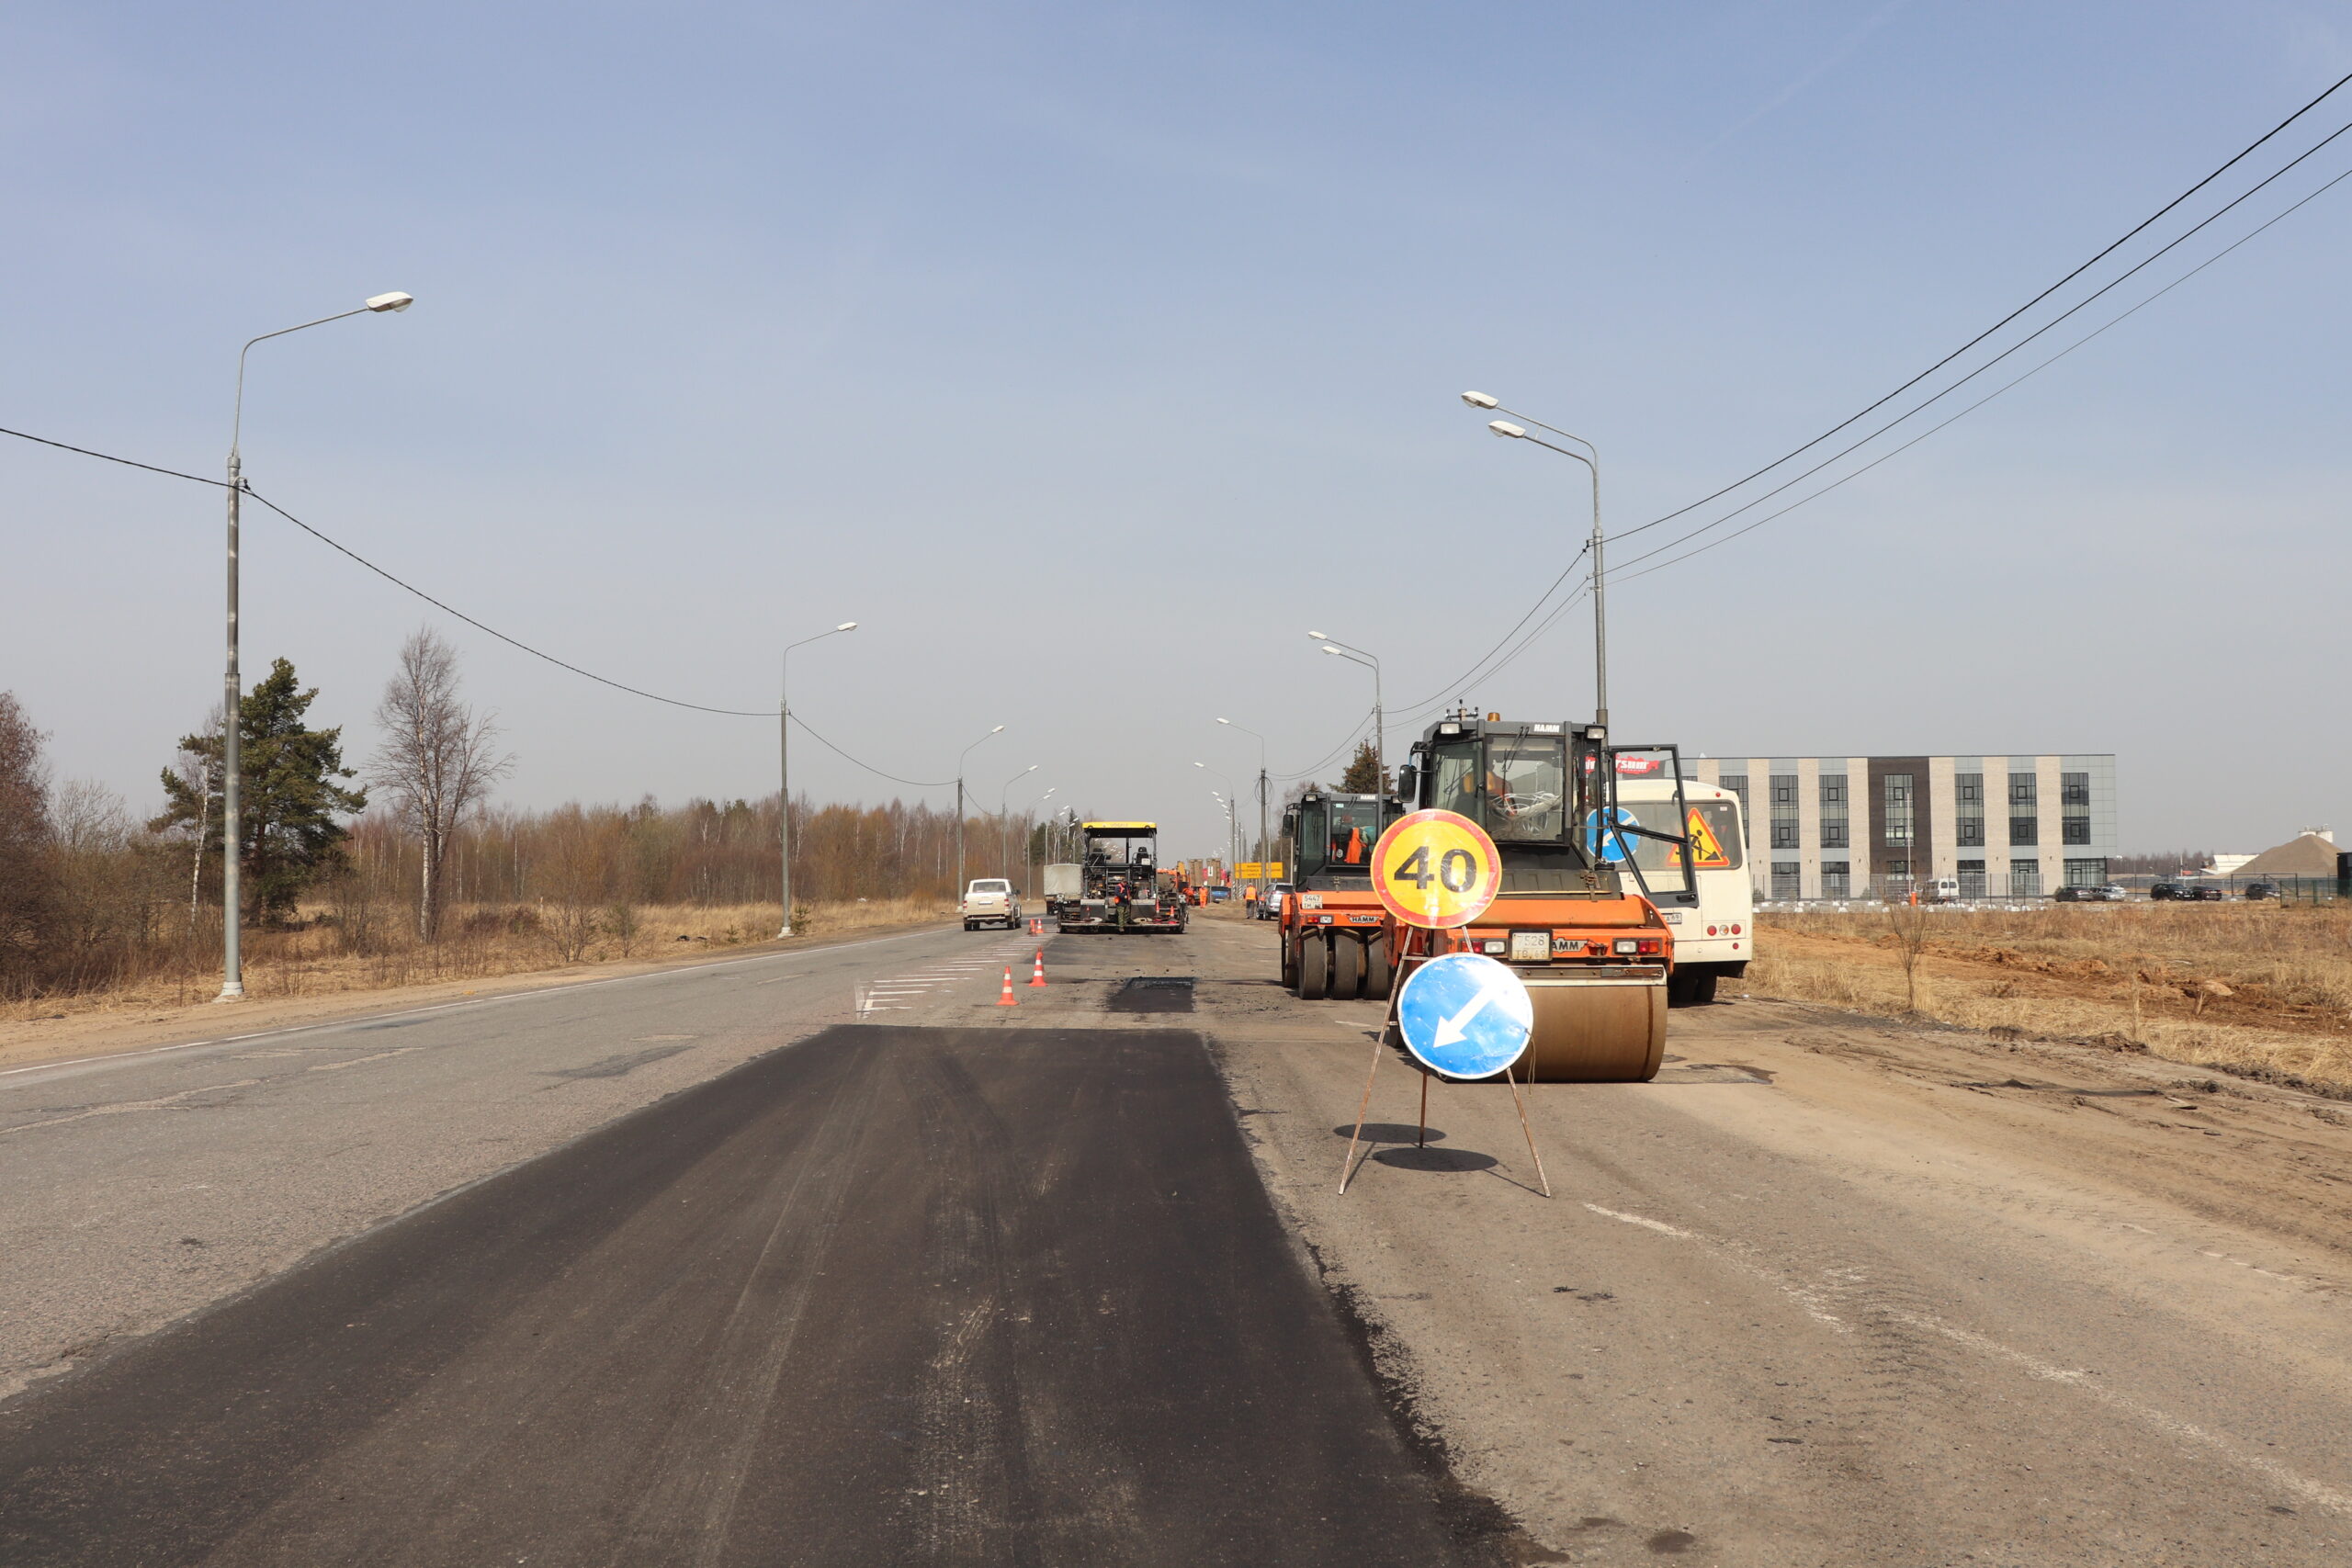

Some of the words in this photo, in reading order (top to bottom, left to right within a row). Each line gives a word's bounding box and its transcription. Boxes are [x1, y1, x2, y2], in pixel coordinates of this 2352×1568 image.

[1533, 724, 1560, 733] HAMM
[1394, 846, 1476, 893] 40
[1553, 941, 1579, 951] AMM
